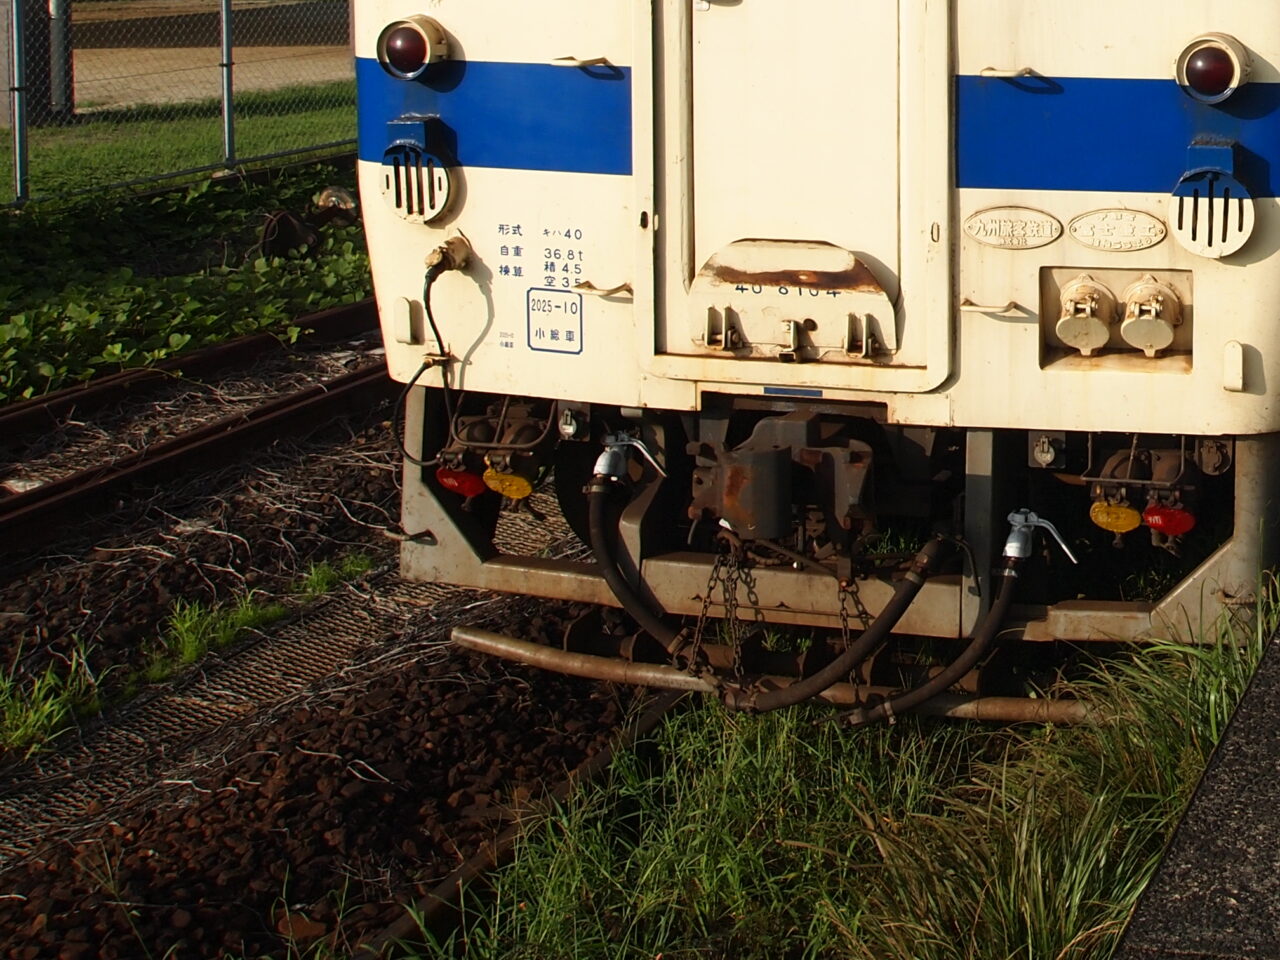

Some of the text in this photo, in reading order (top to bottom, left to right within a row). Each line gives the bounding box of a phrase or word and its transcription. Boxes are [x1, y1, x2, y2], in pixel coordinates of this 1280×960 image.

[498, 224, 583, 240] 形式 キハ40
[500, 245, 524, 257] 自重
[562, 263, 582, 274] 4.5
[544, 276, 556, 287] 空
[531, 298, 578, 315] 2025-10
